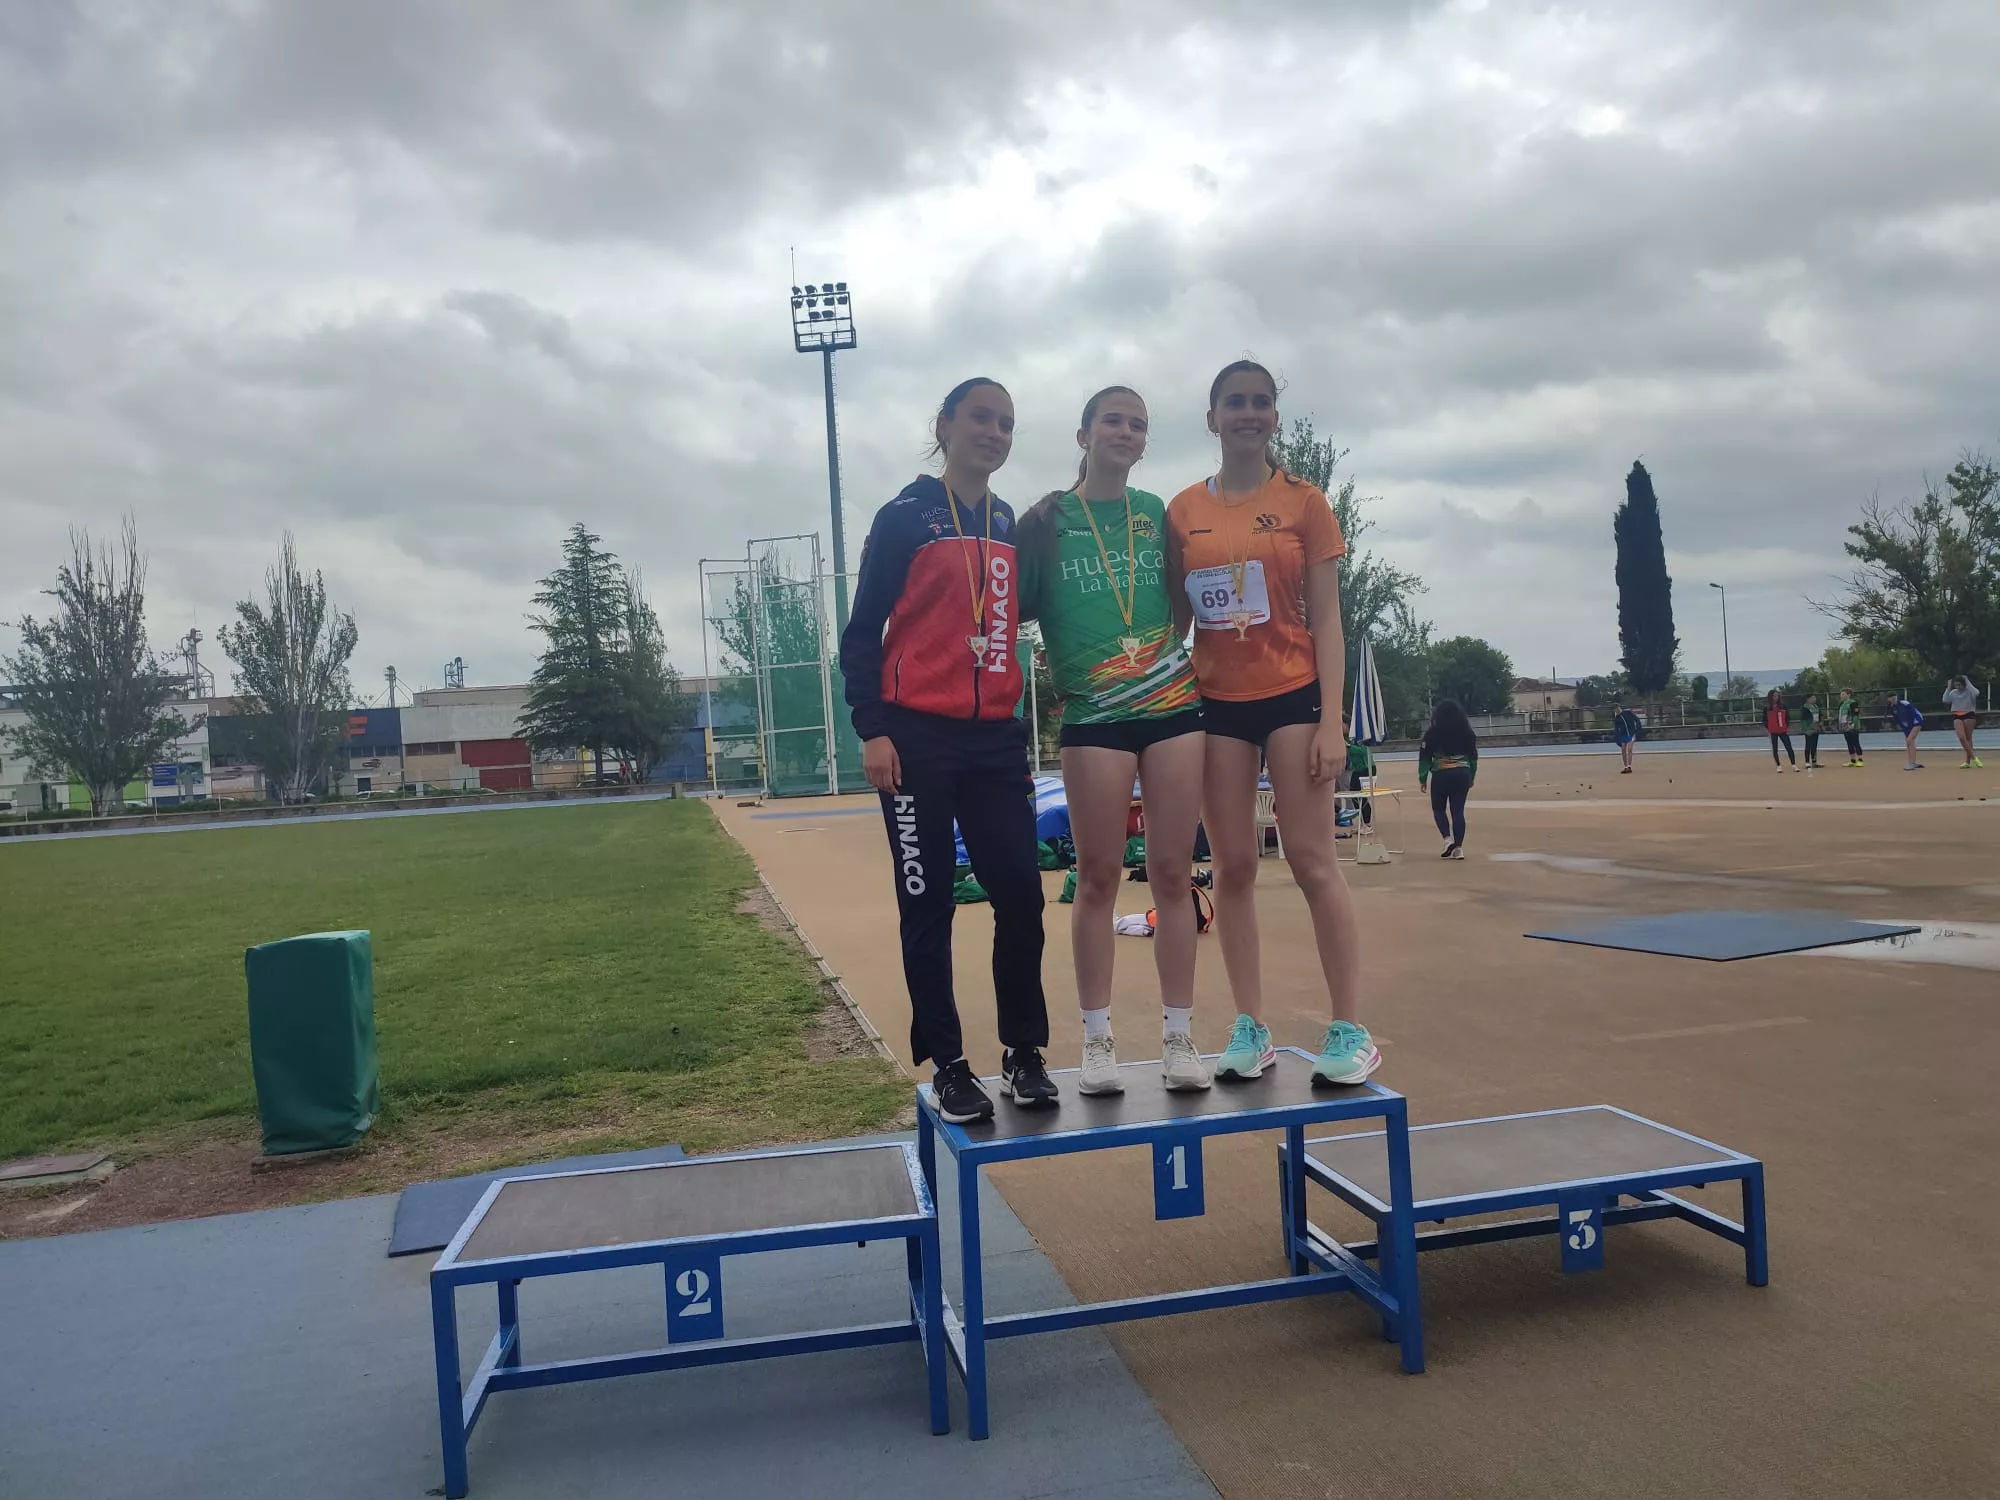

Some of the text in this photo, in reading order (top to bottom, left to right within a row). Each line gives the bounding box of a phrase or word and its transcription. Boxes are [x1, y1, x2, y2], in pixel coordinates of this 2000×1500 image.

[1131, 520, 1155, 529] ntec
[1059, 549, 1165, 580] Huesca
[1080, 577, 1101, 593] La
[988, 556, 1010, 672] HINACO
[894, 795, 926, 896] HINACO
[1166, 1146, 1189, 1190] 1
[1568, 1209, 1597, 1250] 3
[675, 1269, 712, 1317] 2
